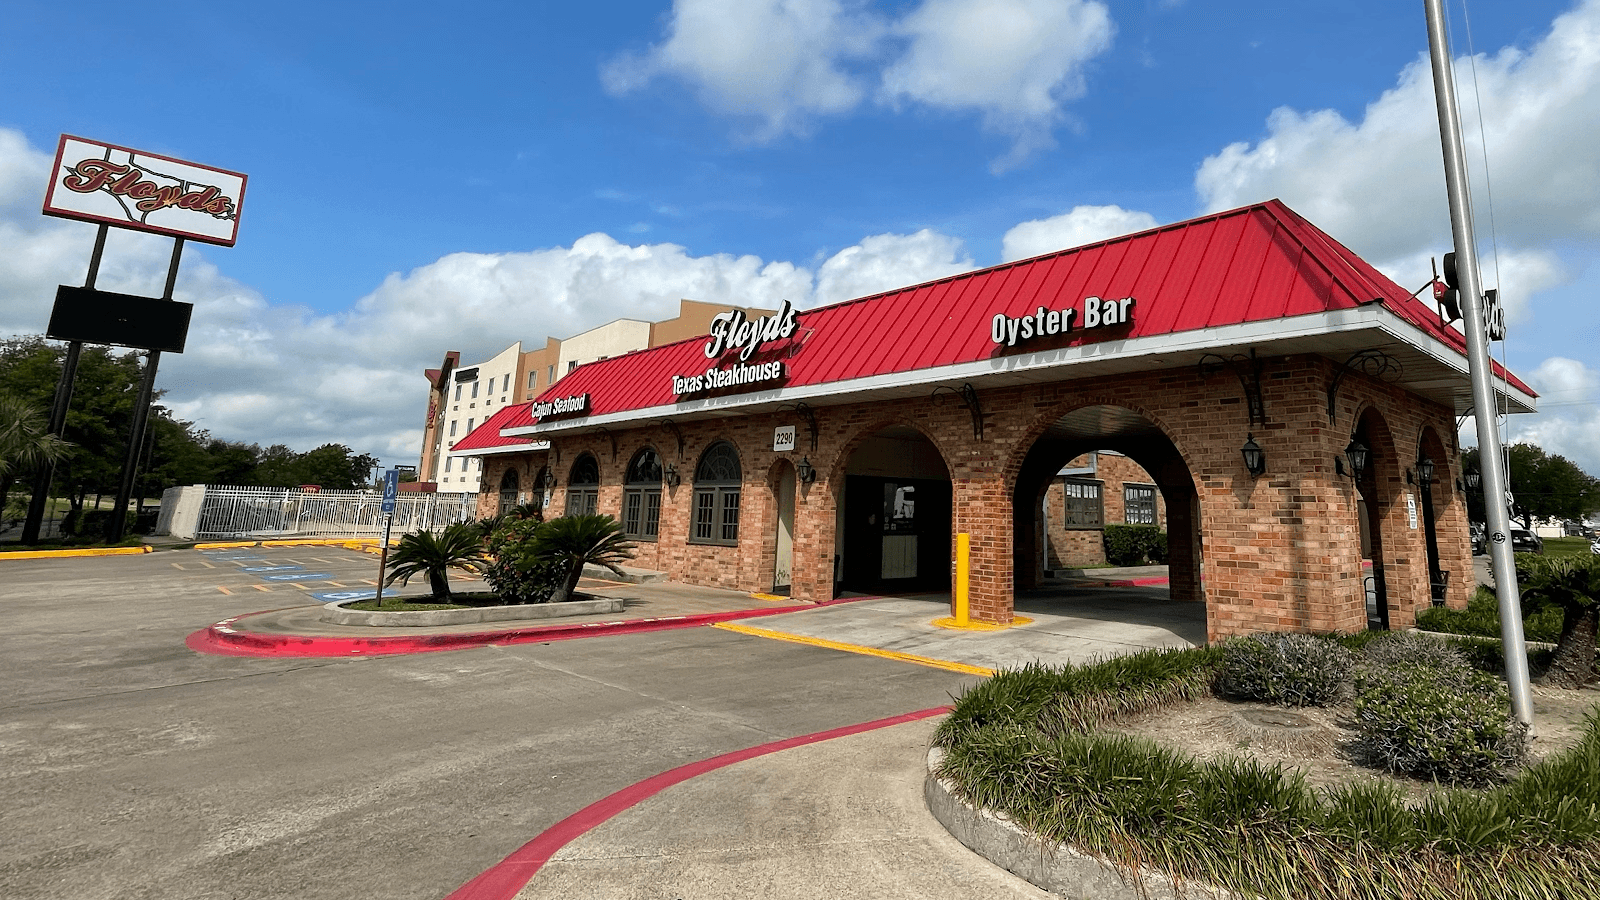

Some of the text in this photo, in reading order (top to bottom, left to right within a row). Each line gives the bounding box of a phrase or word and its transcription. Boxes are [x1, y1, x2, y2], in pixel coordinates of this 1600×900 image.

[63, 159, 232, 213] Floyds
[704, 299, 796, 361] Floyds
[992, 296, 1132, 346] Oyster Bar
[672, 361, 781, 395] Texas Steakhouse
[532, 392, 586, 421] Cajun Seafood
[776, 432, 793, 445] 2290
